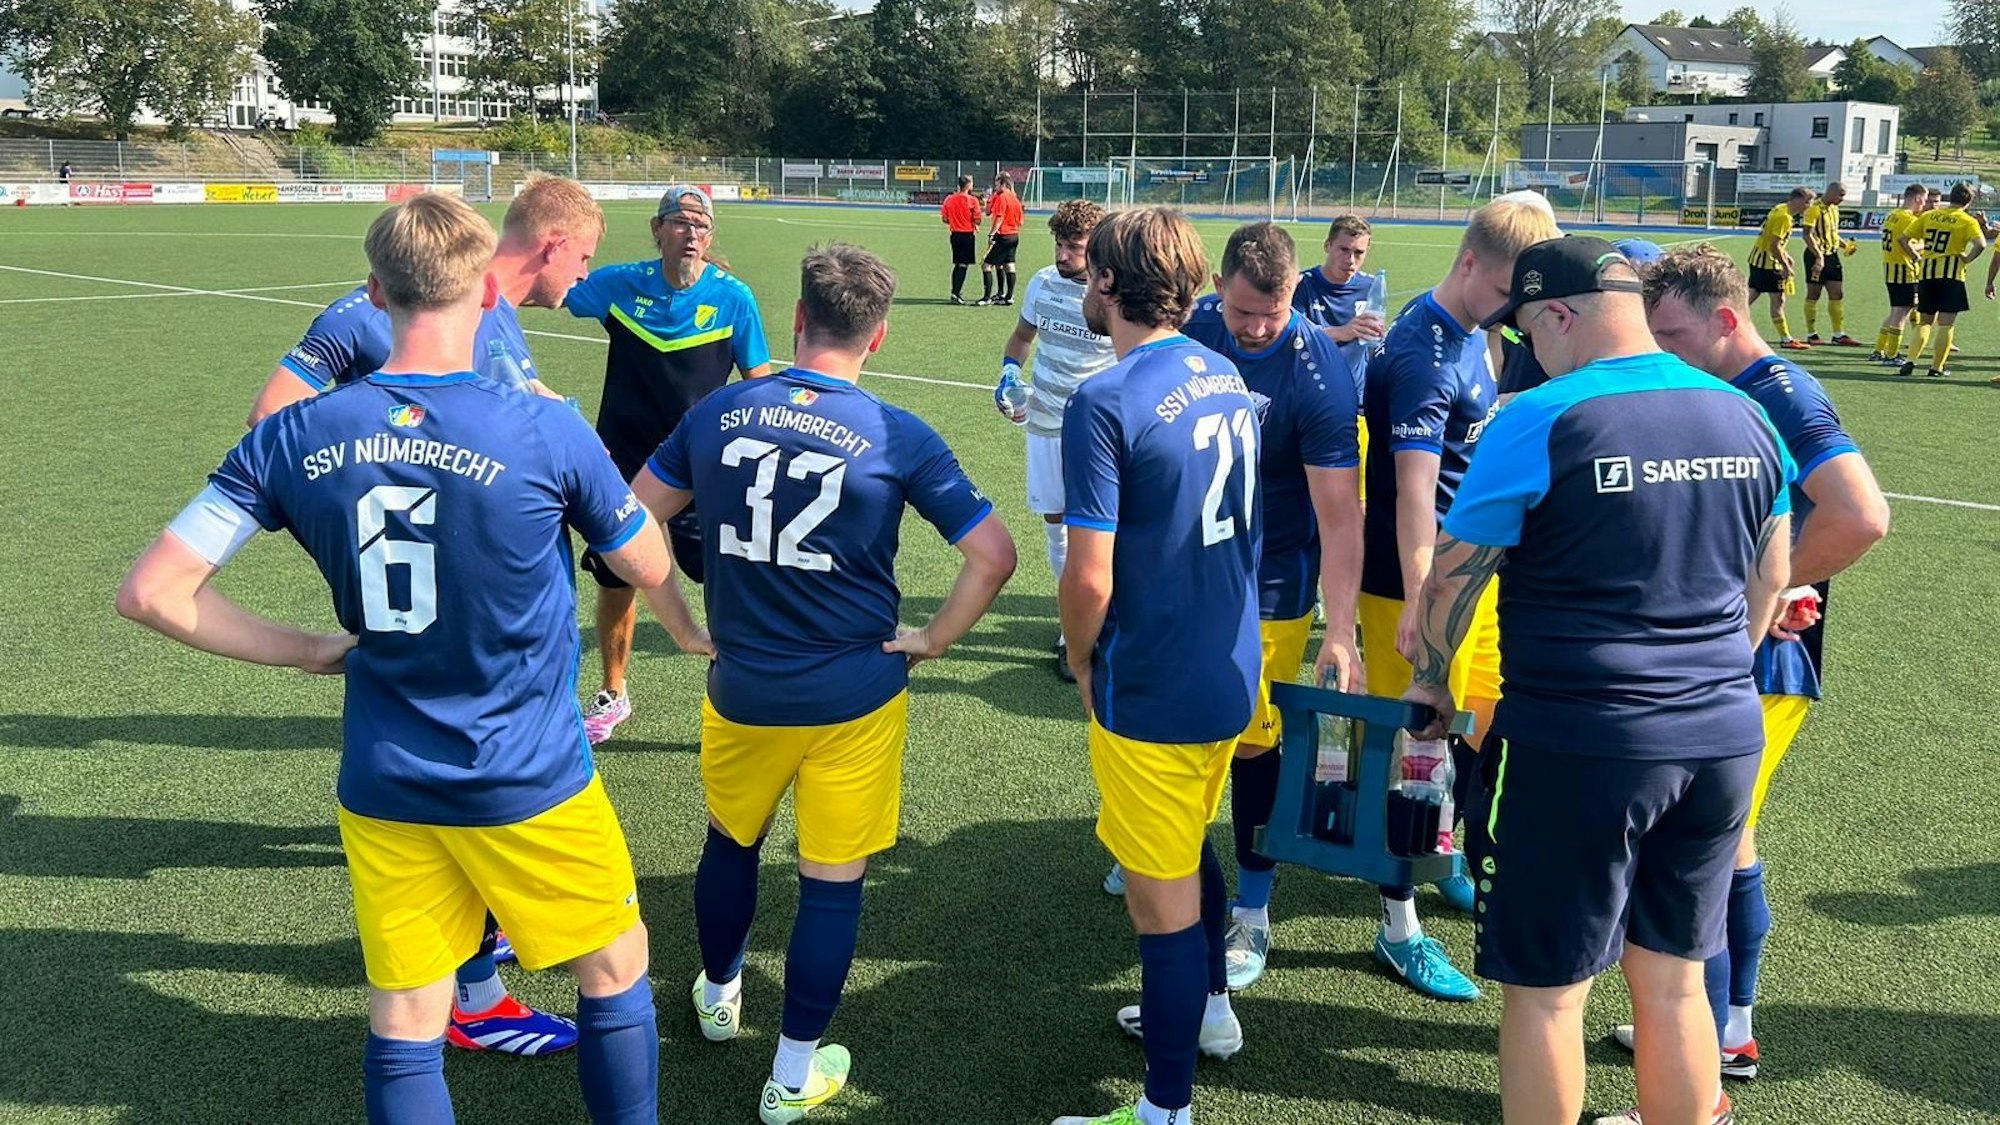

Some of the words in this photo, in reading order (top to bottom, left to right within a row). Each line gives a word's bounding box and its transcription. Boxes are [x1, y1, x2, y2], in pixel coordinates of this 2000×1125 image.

[1924, 228, 1951, 253] 28
[720, 407, 753, 431] SSV
[758, 405, 872, 458] NÜMBRECHT
[1155, 387, 1189, 425] SSV
[303, 442, 345, 480] SSV
[355, 433, 506, 486] NÜMBRECHT
[1192, 408, 1256, 547] 21
[1642, 456, 1761, 484] SARSTEDT
[719, 436, 847, 572] 32
[357, 485, 437, 634] 6
